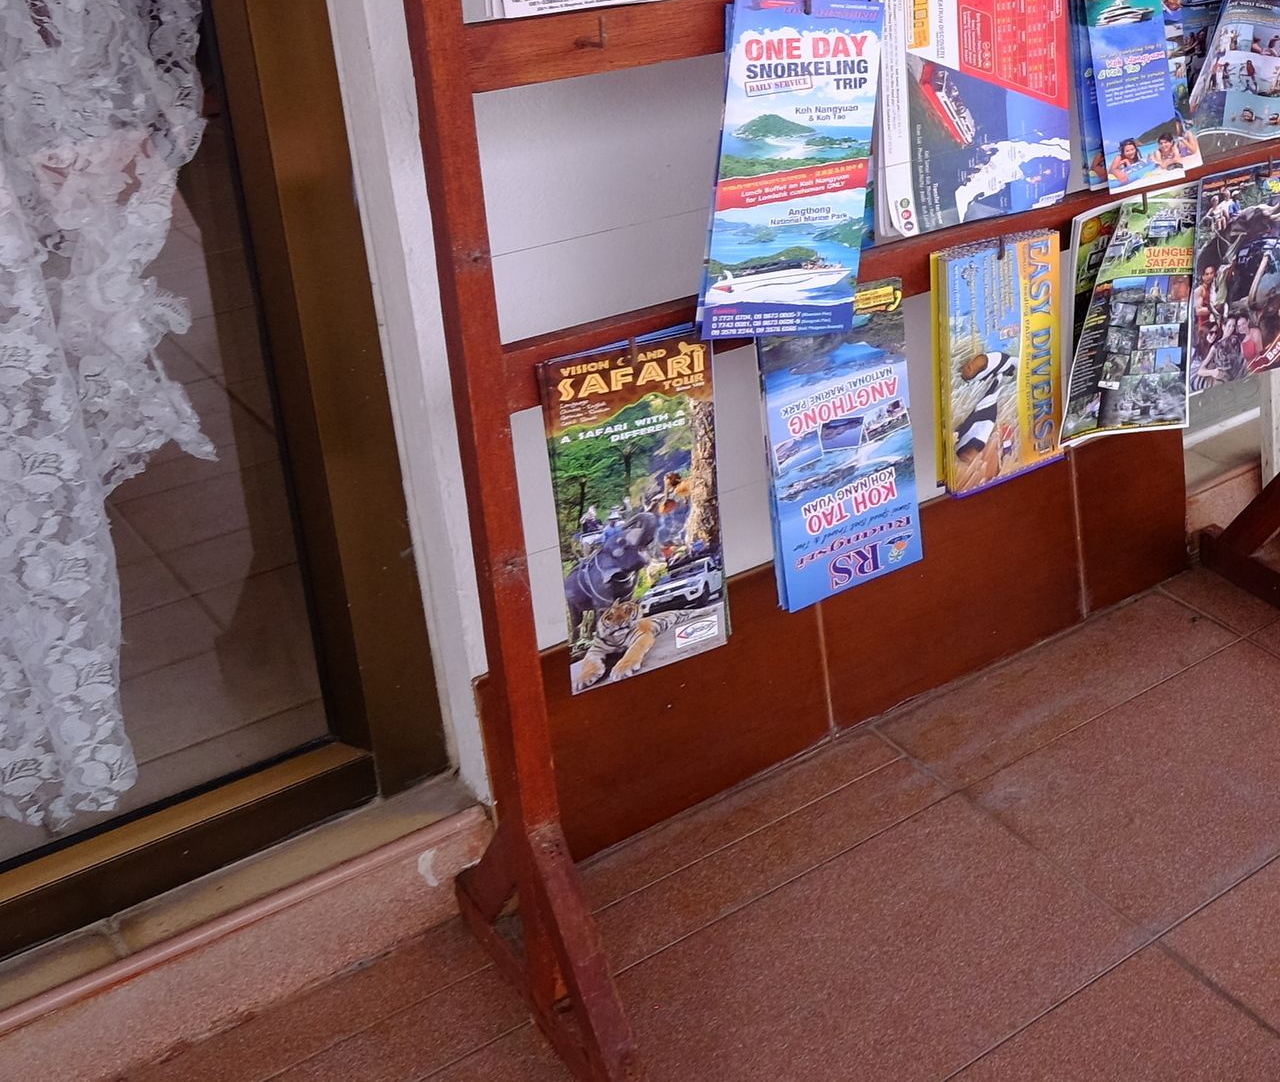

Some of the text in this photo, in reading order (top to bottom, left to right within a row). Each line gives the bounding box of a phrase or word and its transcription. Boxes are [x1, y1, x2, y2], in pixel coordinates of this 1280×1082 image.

[745, 35, 868, 61] ONE DAY
[746, 59, 869, 79] SNORKELING
[749, 78, 808, 92] DAILY SERVICE
[833, 77, 868, 91] TRIP
[795, 104, 859, 115] Koh Nangyuan
[745, 196, 757, 204] for
[827, 180, 845, 189] ONLY
[764, 184, 787, 194] Buffet
[799, 179, 814, 188] Koh
[770, 215, 802, 226] National
[831, 211, 848, 220] Park
[788, 205, 831, 217] Angthong
[1145, 258, 1190, 268] SAFARI
[1146, 247, 1193, 259] JUNGLE
[1027, 236, 1054, 440] EASY DIVERS
[557, 348, 705, 402] SAFARI
[560, 359, 610, 379] VISION
[663, 372, 704, 390] TOUR
[782, 366, 893, 416] NATIONAL MARINE PARK
[789, 376, 897, 435] ANGTHONG
[560, 409, 686, 444] A SAFARI WITH A
[610, 418, 686, 442] DIFFERENCE
[802, 467, 896, 517] KOH NANG YUAN
[806, 480, 897, 535] KOH TAO
[830, 542, 885, 589] RS
